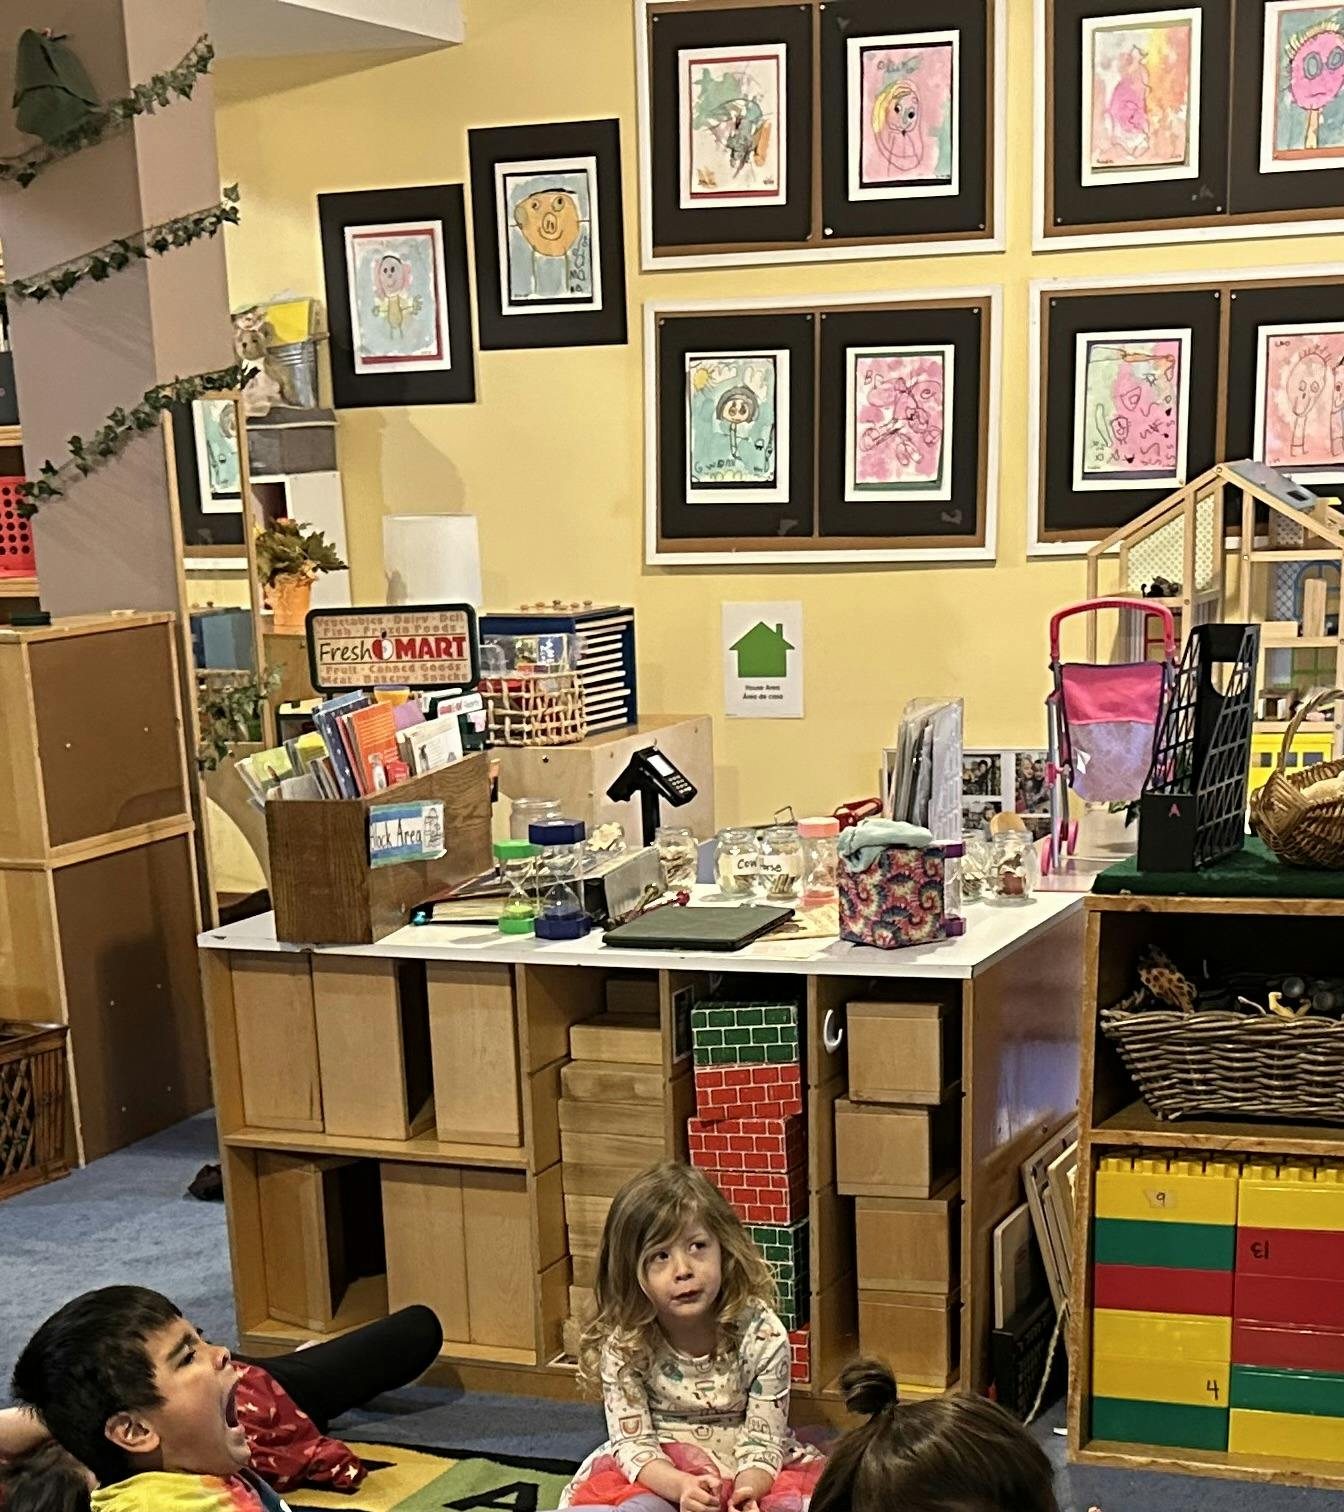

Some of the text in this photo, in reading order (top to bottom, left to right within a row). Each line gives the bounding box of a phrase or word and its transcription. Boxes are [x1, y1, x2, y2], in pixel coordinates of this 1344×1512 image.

[319, 636, 466, 661] Fresh MART
[1168, 803, 1181, 818] A
[370, 820, 393, 850] lock
[1206, 1379, 1220, 1401] 4
